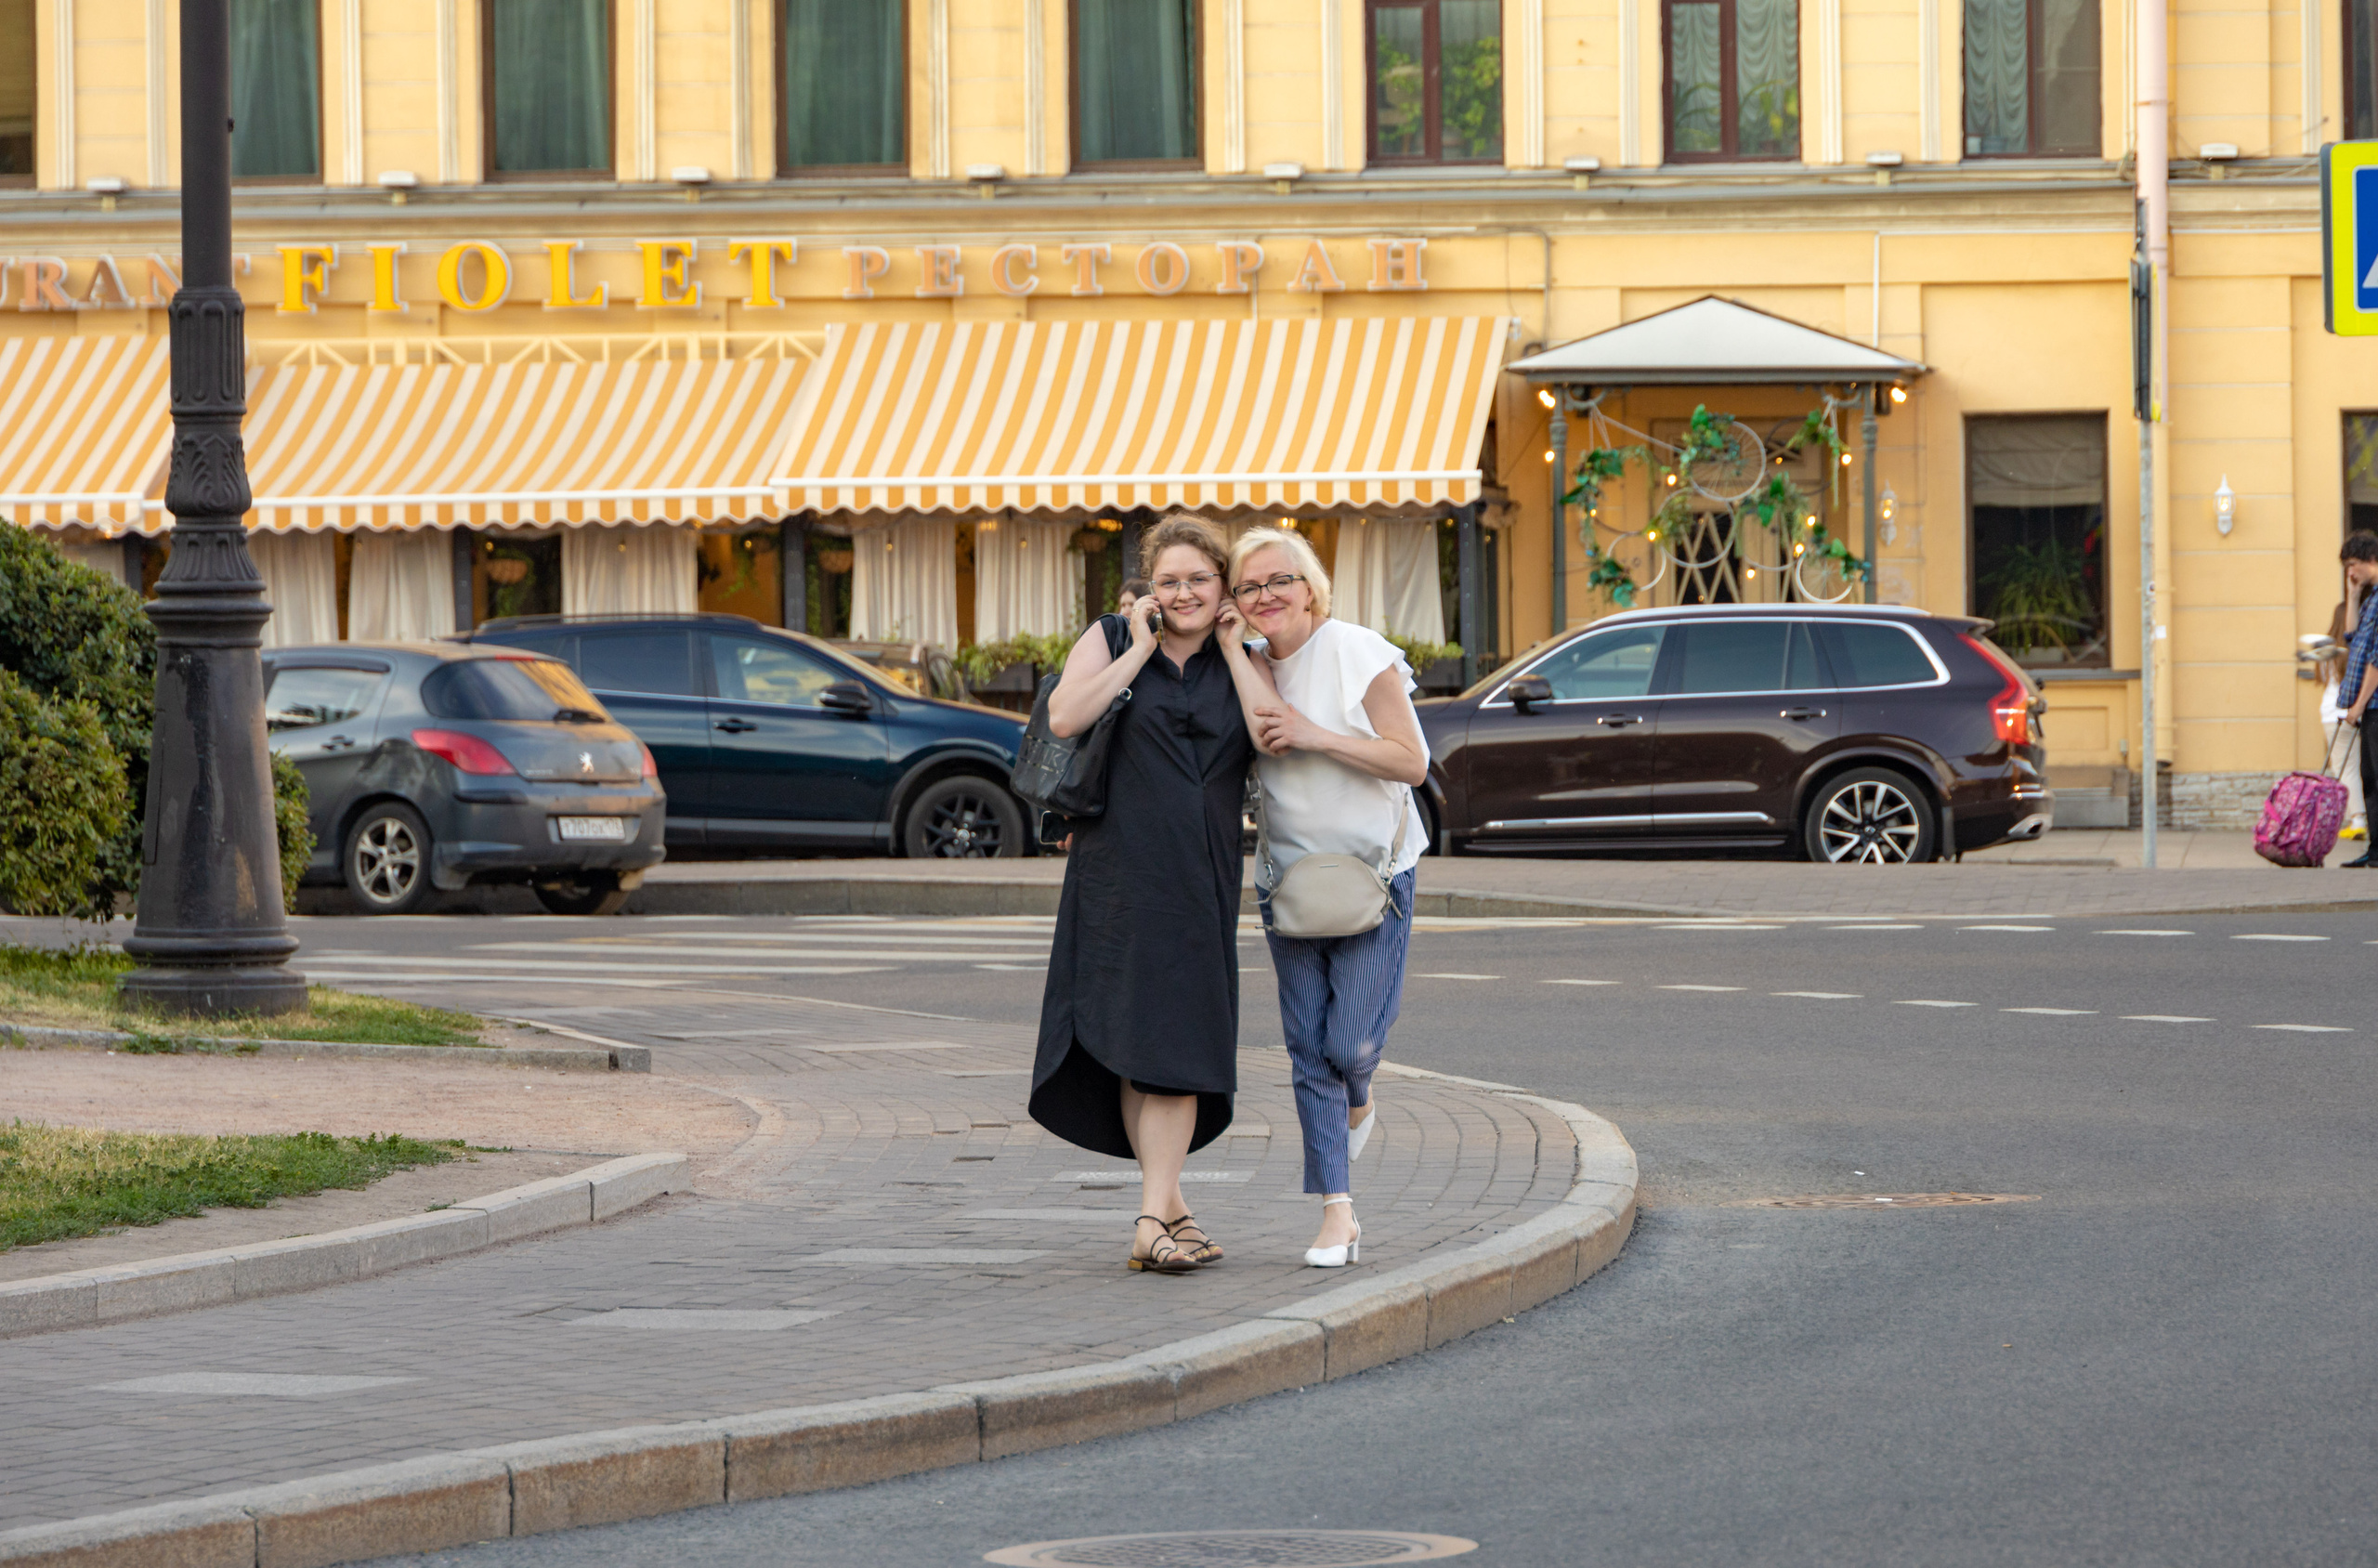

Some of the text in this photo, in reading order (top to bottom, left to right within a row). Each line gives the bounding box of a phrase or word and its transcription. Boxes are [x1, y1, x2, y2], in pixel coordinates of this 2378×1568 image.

[0, 239, 797, 315] RAN FIOLET
[842, 237, 1428, 298] РЕСТОРАН
